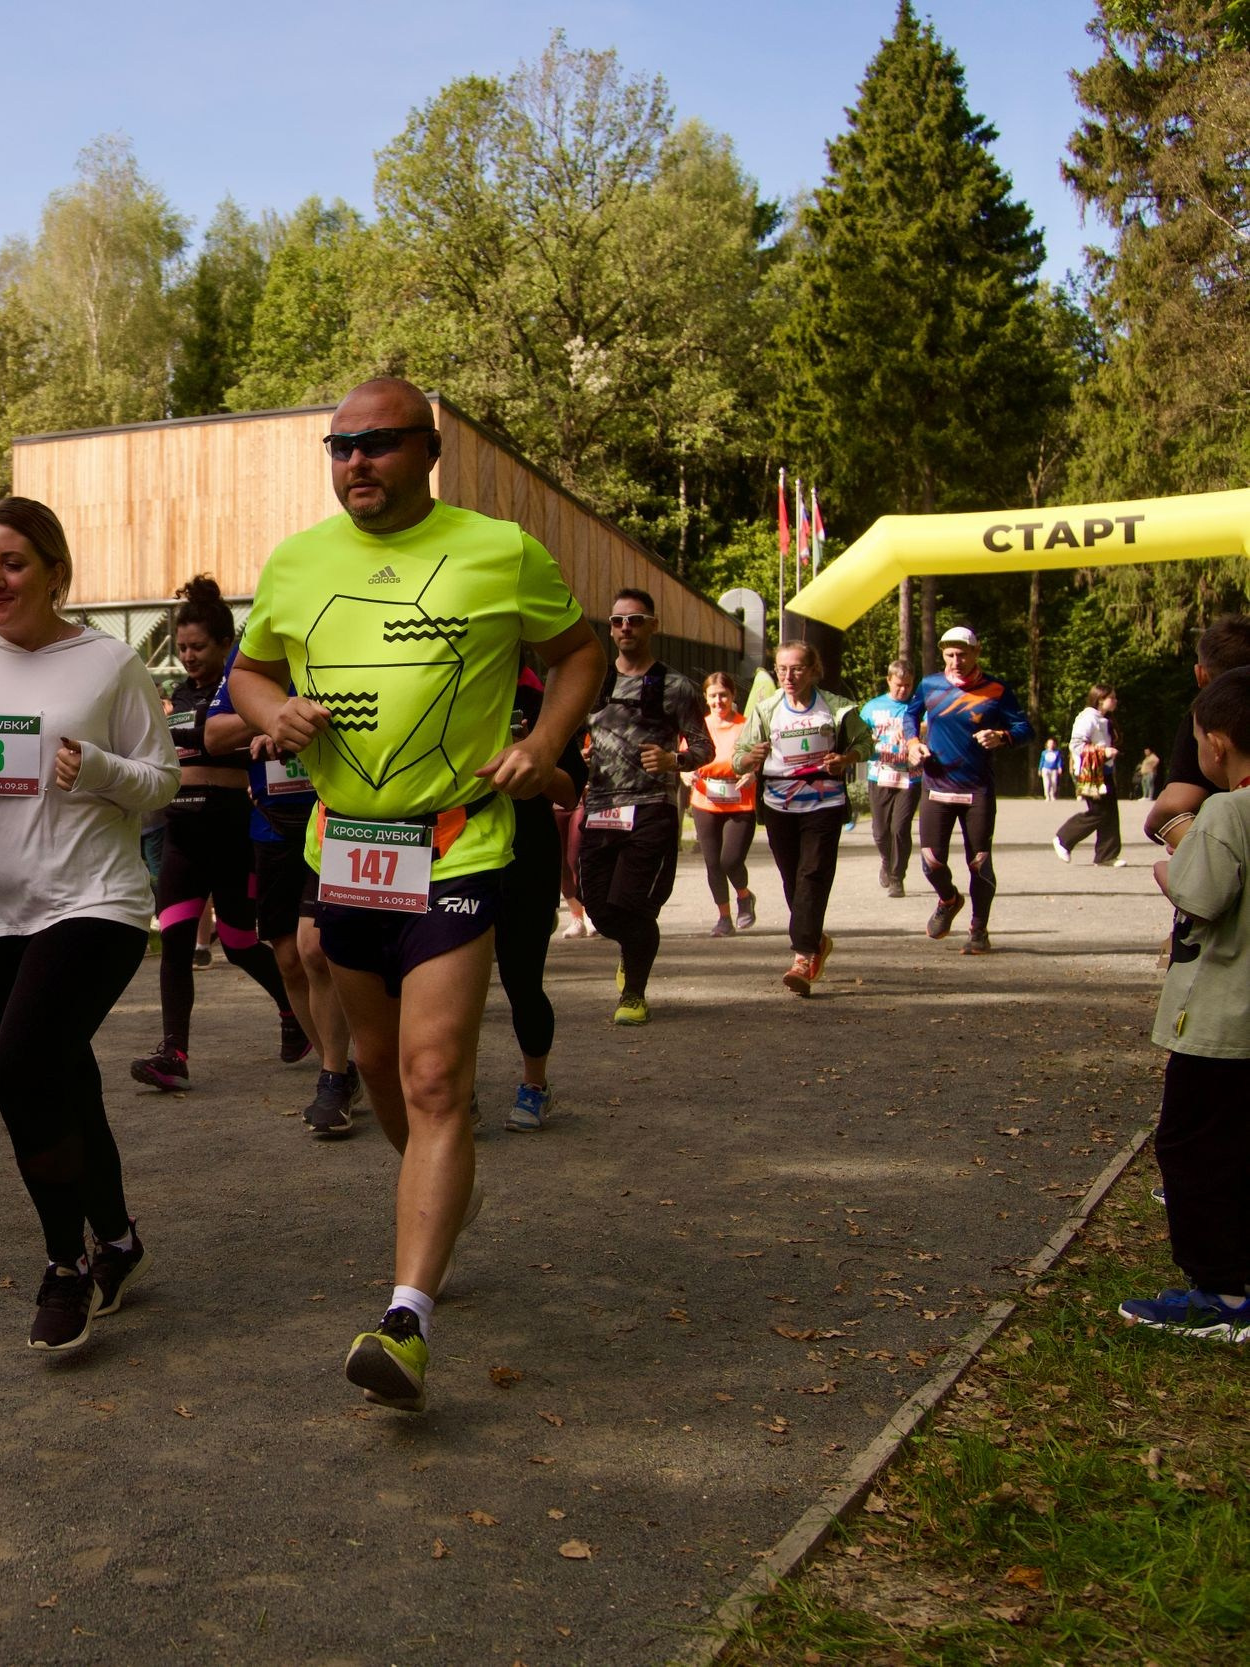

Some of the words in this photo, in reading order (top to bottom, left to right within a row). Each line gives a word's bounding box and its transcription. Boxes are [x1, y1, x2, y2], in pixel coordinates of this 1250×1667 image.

[983, 515, 1145, 553] СТАРТ
[368, 576, 401, 585] adidas
[801, 738, 809, 752] 4
[332, 825, 373, 840] КРОСС
[375, 829, 421, 843] ДУБКИ
[347, 848, 399, 886] 147
[328, 890, 371, 903] Апрелевка
[378, 896, 418, 907] 14.09.25
